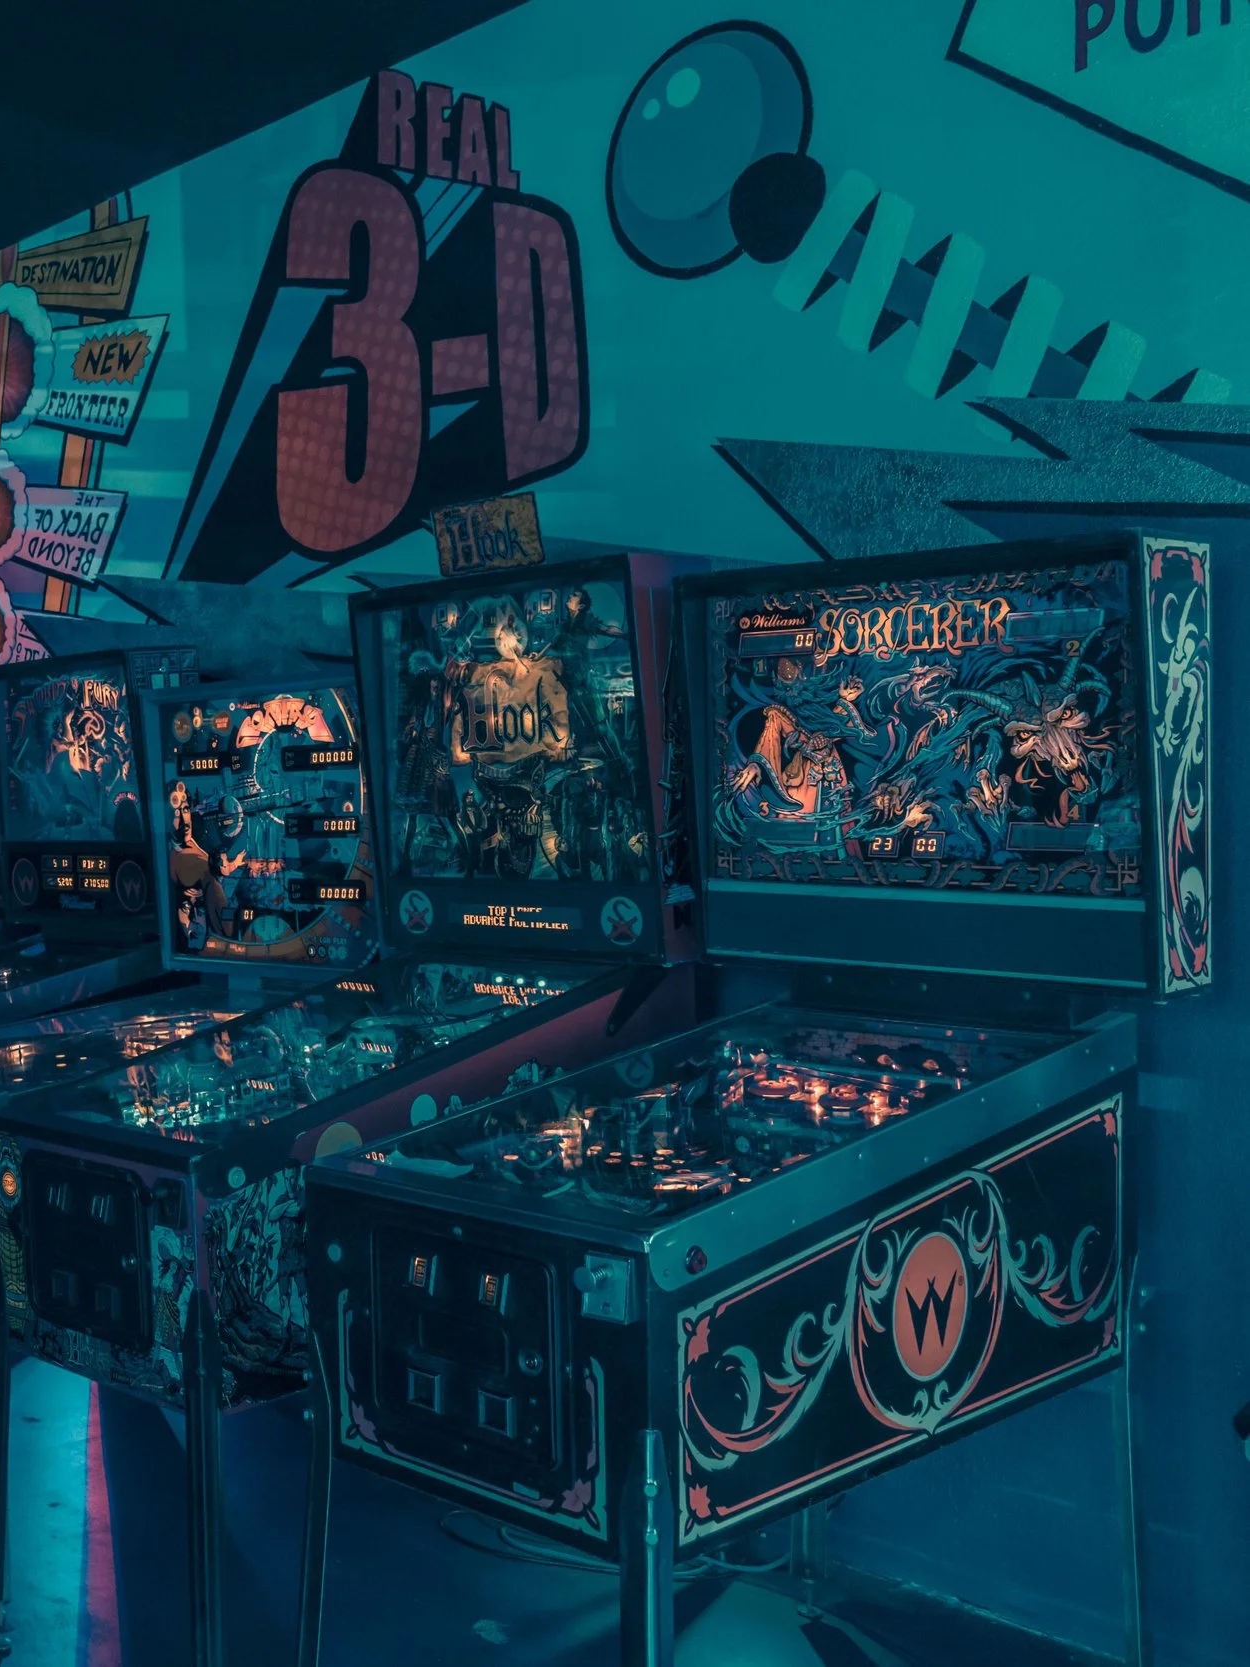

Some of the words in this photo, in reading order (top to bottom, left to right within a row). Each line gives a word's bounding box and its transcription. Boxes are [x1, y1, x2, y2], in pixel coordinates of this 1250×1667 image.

[376, 67, 521, 191] REAL
[21, 253, 123, 285] DESTINATION
[83, 341, 142, 376] NEW
[276, 167, 582, 553] 3-D
[47, 389, 130, 429] FRONTIER
[444, 511, 530, 573] Hook
[751, 613, 806, 629] Williams
[813, 592, 1016, 668] SORCERER
[794, 633, 814, 647] 00
[1065, 639, 1081, 657] 2
[756, 658, 764, 673] 1
[81, 679, 119, 712] FURY
[457, 669, 564, 753] Hook
[871, 837, 893, 851] 23
[915, 838, 937, 852] 00
[463, 914, 506, 927] ADVANCE
[488, 905, 508, 917] TOP
